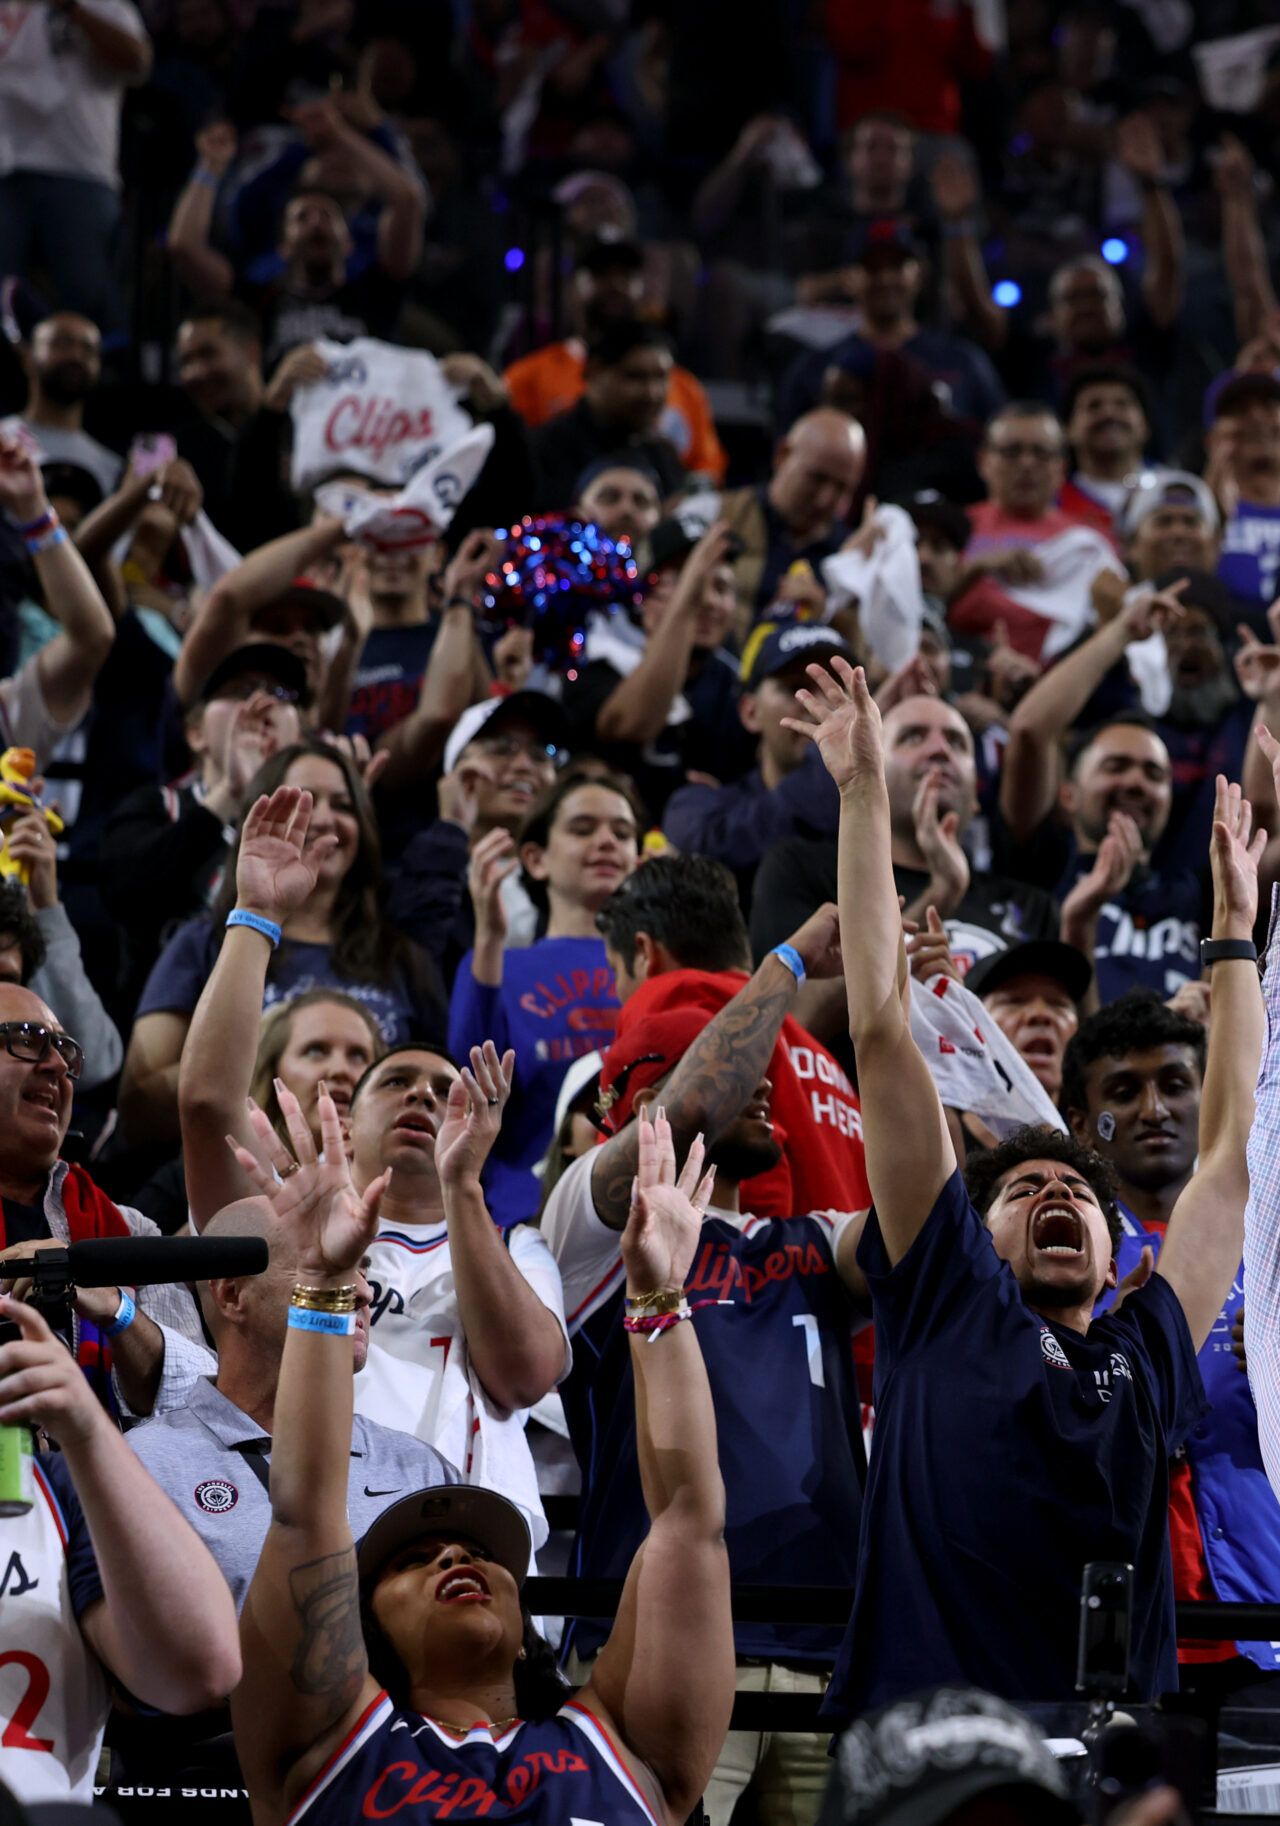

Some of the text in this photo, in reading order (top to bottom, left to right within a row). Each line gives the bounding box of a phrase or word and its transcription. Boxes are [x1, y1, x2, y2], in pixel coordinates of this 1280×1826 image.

[325, 395, 435, 465] Clips
[684, 1242, 831, 1304] lippers
[791, 1313, 826, 1389] 1
[0, 1650, 54, 1753] 2
[116, 1786, 172, 1797] FOR
